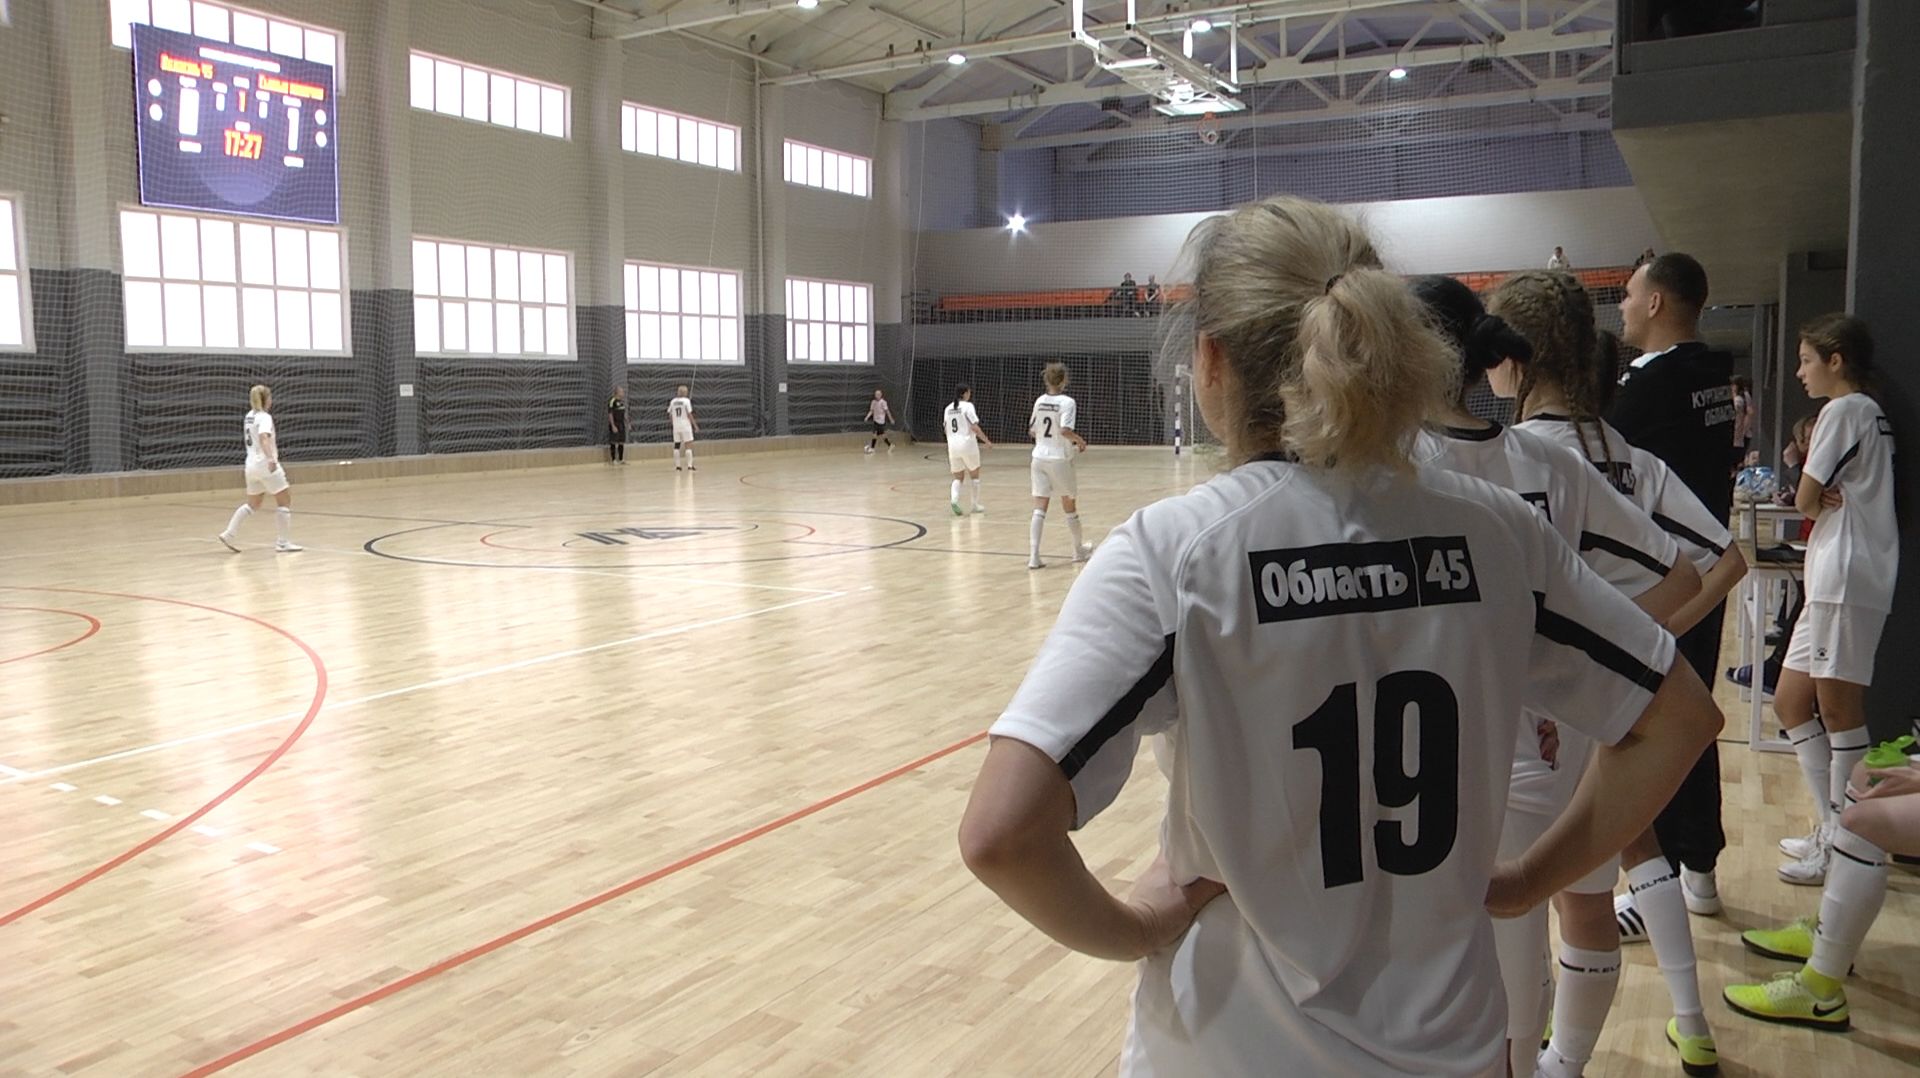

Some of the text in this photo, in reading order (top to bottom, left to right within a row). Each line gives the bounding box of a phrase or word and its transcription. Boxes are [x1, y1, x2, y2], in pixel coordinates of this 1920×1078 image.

[224, 128, 263, 160] 17:27
[951, 418, 958, 433] 9
[1043, 417, 1052, 438] 2
[1261, 550, 1471, 608] Область 45
[1292, 670, 1459, 889] 19
